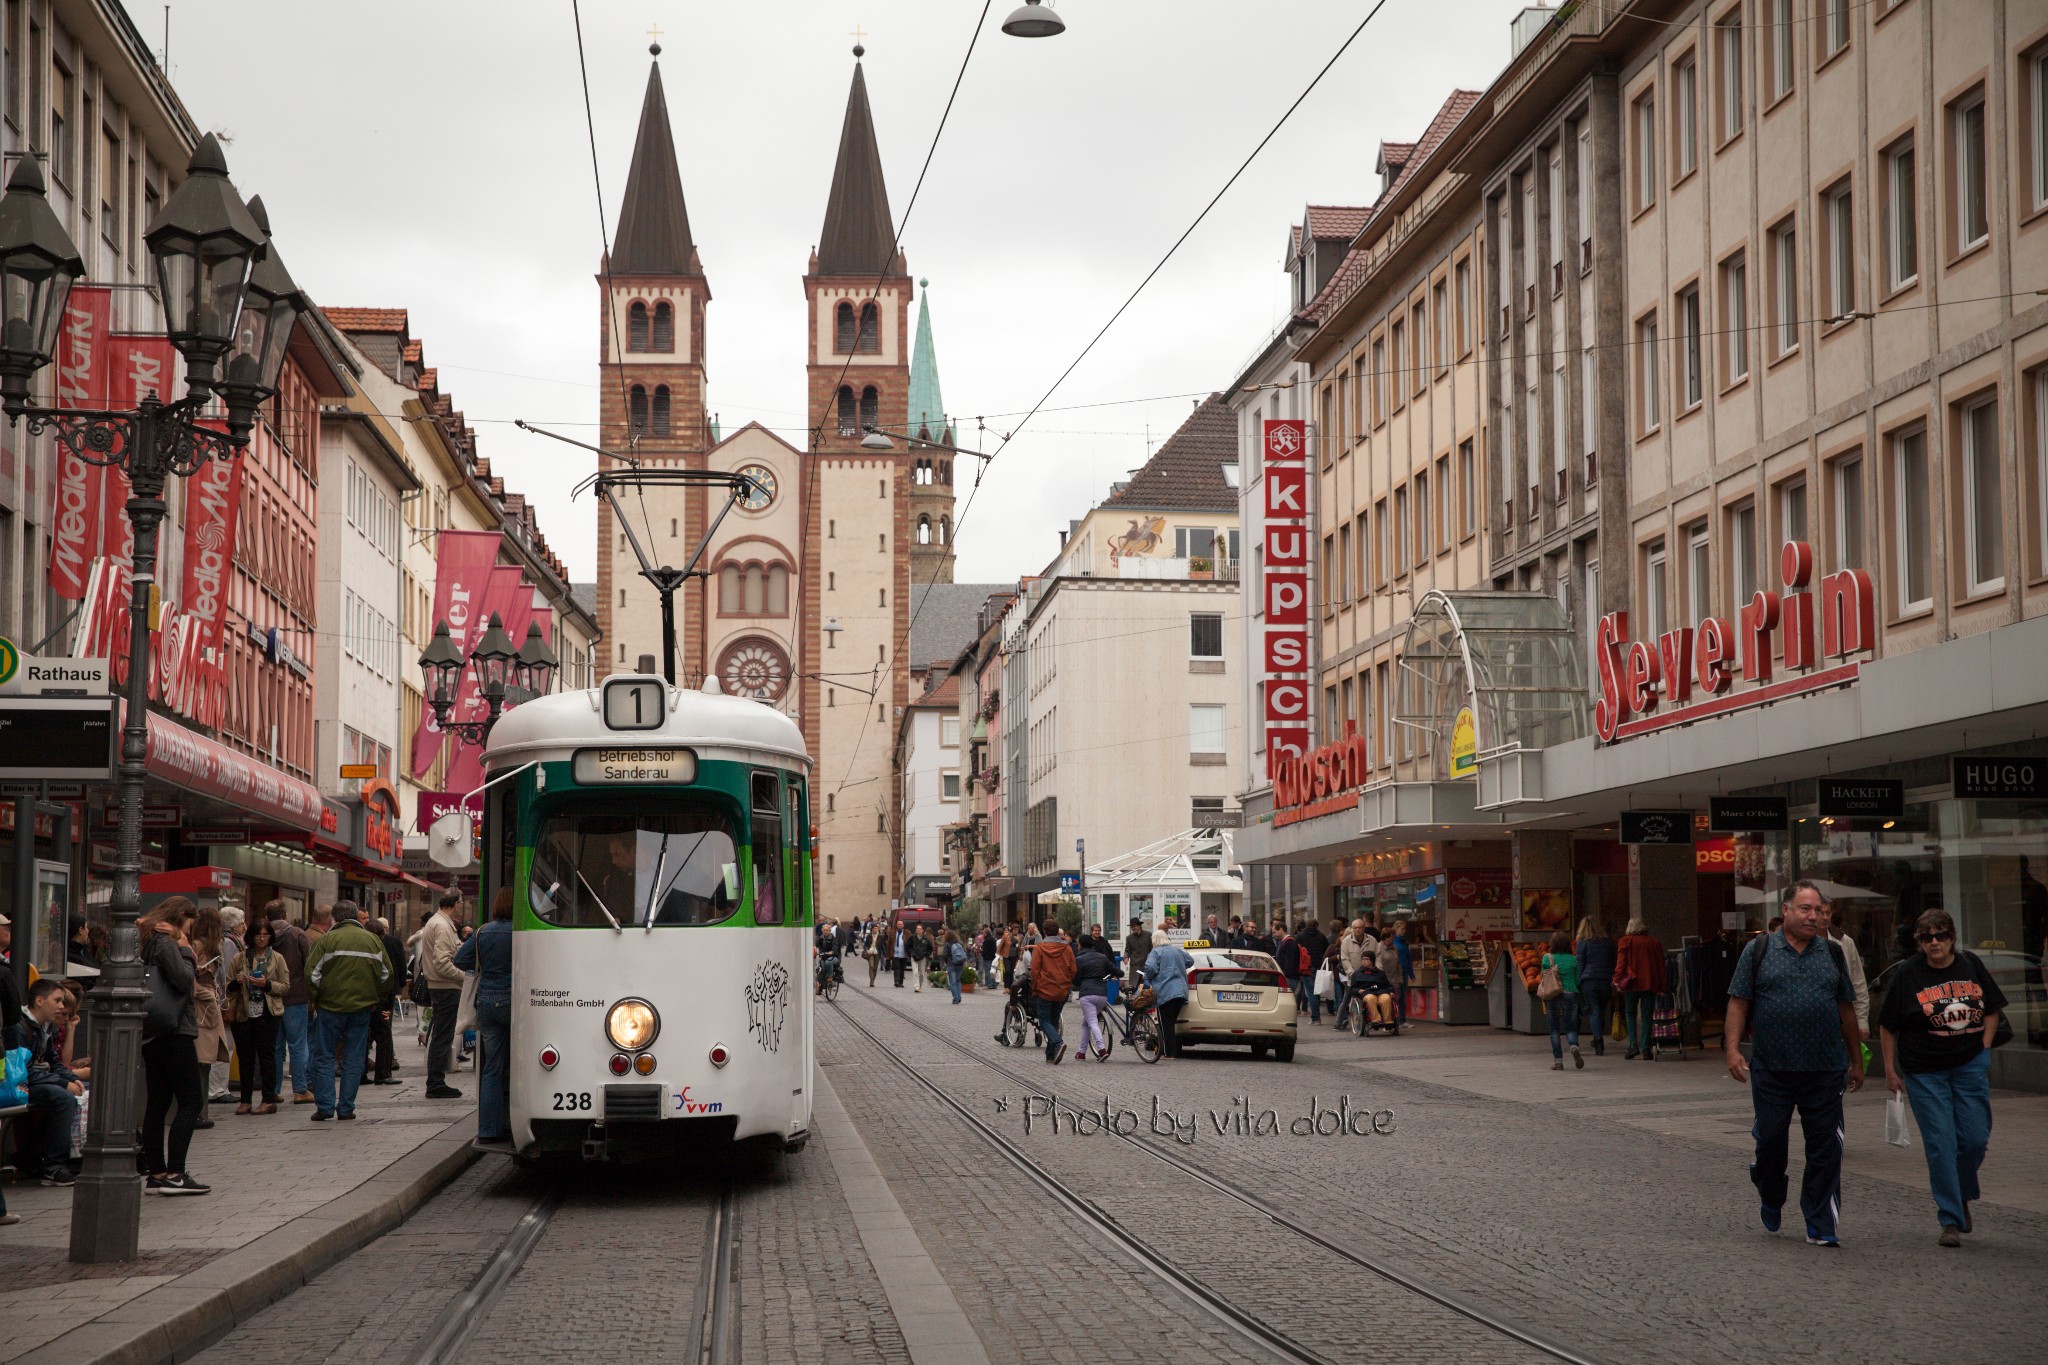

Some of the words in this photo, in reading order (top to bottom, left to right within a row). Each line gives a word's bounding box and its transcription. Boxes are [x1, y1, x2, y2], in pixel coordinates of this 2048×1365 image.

[1596, 541, 1874, 742] Severin
[29, 666, 102, 682] Rathaus
[630, 688, 642, 724] 1
[599, 751, 676, 763] Betriebshof
[604, 766, 669, 780] Sanderau
[1272, 719, 1367, 812] kupsch
[1966, 765, 2035, 785] HUGO
[1832, 786, 1891, 798] HACKETT
[530, 988, 571, 998] Würzburger
[530, 998, 574, 1007] Straßenbahn
[576, 999, 605, 1008] GmbH
[1930, 1008, 1983, 1028] GIANTS
[553, 1092, 592, 1111] 238
[686, 1102, 723, 1114] vvm
